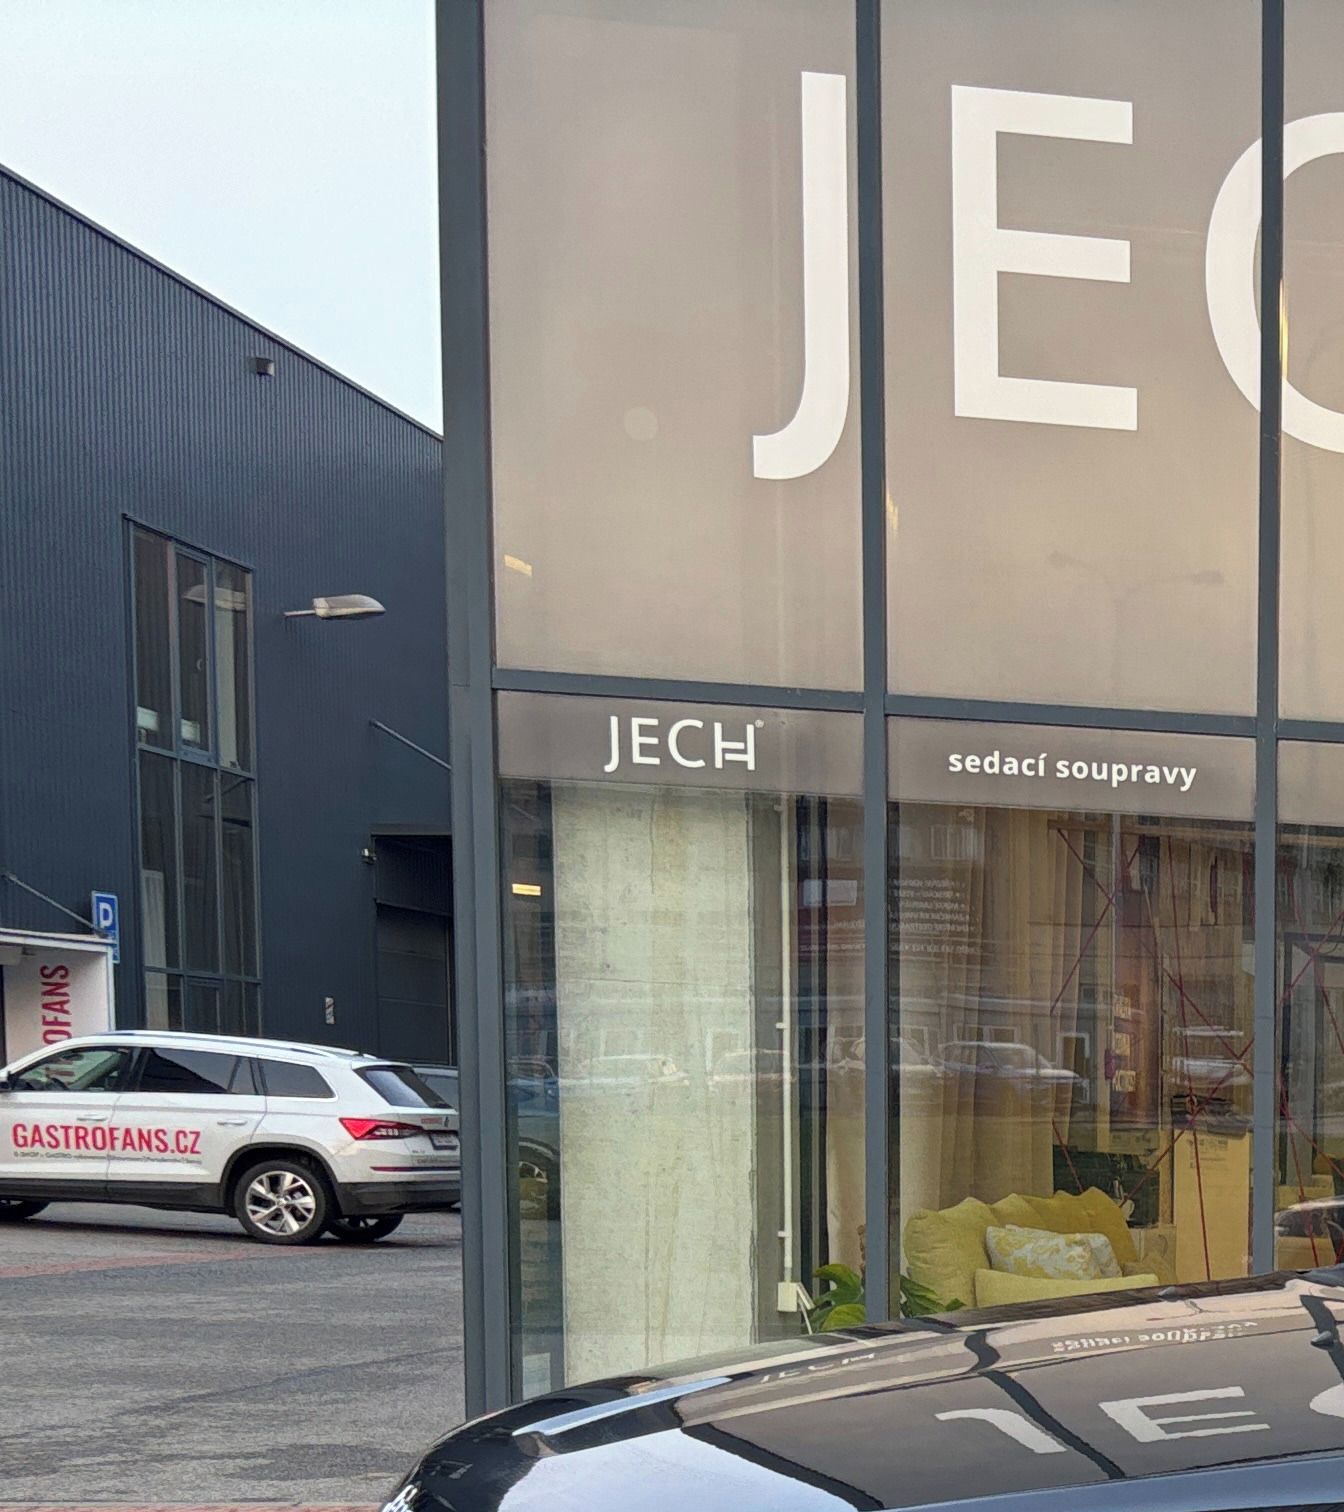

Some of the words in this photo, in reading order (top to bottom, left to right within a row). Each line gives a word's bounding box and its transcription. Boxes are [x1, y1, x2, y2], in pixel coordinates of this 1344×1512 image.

[949, 750, 1048, 777] sedací
[1056, 761, 1197, 791] soupravy
[100, 902, 114, 930] P
[12, 1123, 202, 1155] GASTROFANS.CZ
